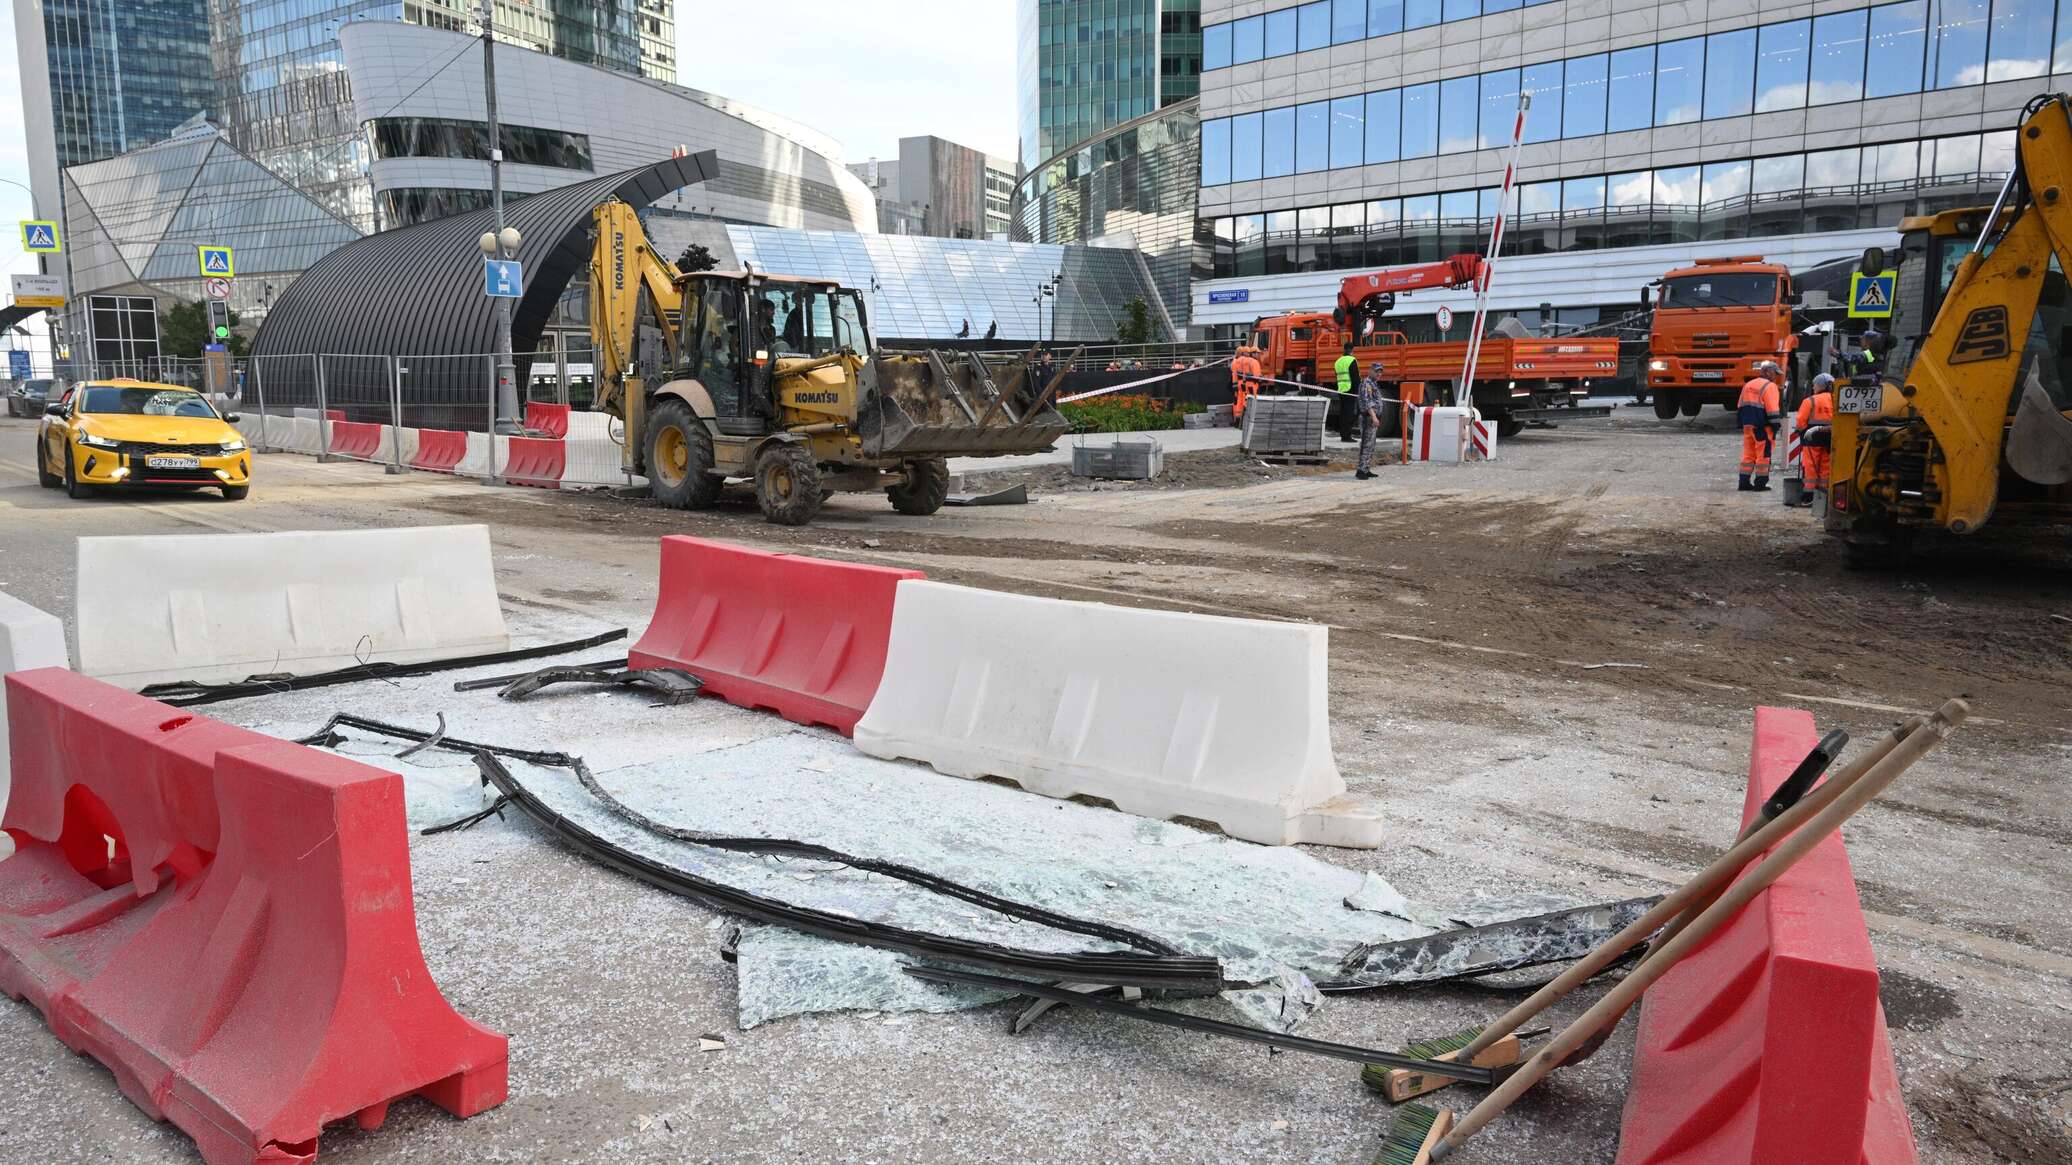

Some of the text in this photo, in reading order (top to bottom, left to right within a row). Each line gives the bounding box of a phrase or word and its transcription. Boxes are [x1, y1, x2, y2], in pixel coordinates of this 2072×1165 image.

[615, 232, 624, 290] KOMATSU
[1954, 308, 2006, 358] JCB
[795, 390, 838, 403] KOMATSU
[1844, 387, 1877, 399] 0797
[1842, 400, 1878, 411] ХР 50
